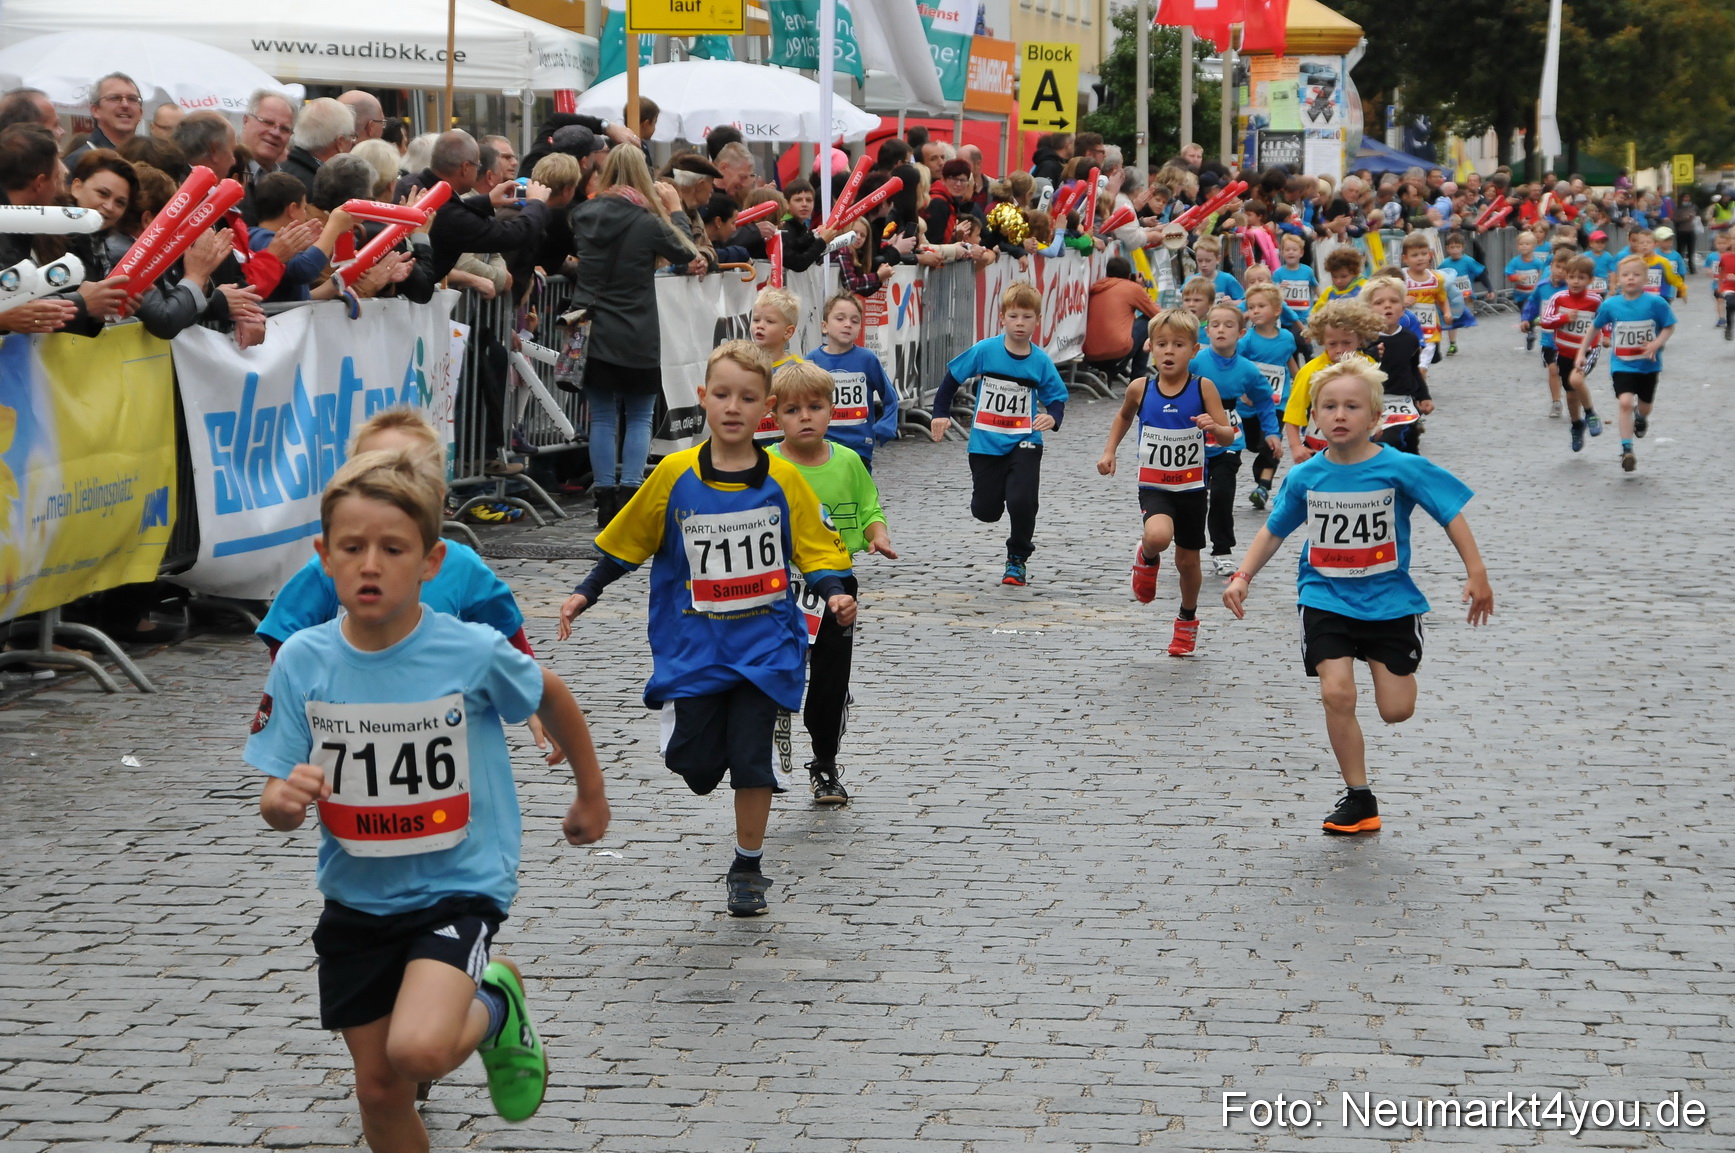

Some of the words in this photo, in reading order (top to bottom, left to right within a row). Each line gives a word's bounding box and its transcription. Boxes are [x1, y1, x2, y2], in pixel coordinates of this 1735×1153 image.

[1028, 44, 1073, 62] Block
[1030, 68, 1065, 112] A
[180, 94, 220, 110] Audi
[745, 123, 780, 136] BKK
[121, 246, 147, 274] Audi
[141, 223, 166, 248] BKK
[161, 230, 186, 254] BKK
[372, 243, 392, 266] Audi
[1285, 287, 1309, 299] 7011
[1618, 329, 1653, 346] 7056
[985, 390, 1027, 414] 7041
[1142, 431, 1161, 441] PARTL
[1163, 433, 1194, 442] Neumarkt
[1146, 442, 1199, 467] 7082
[1161, 473, 1183, 483] Joris
[1308, 499, 1334, 509] PARTL
[1336, 500, 1380, 510] Neumarkt
[684, 524, 716, 534] PARTL
[718, 518, 767, 534] Neumarkt
[1314, 510, 1387, 544] 7245
[693, 531, 776, 575] 7116
[712, 578, 764, 599] Samuel
[312, 716, 355, 734] PARTL
[359, 717, 439, 734] Neumarkt
[321, 736, 456, 797] 7146
[356, 813, 425, 835] Niklas
